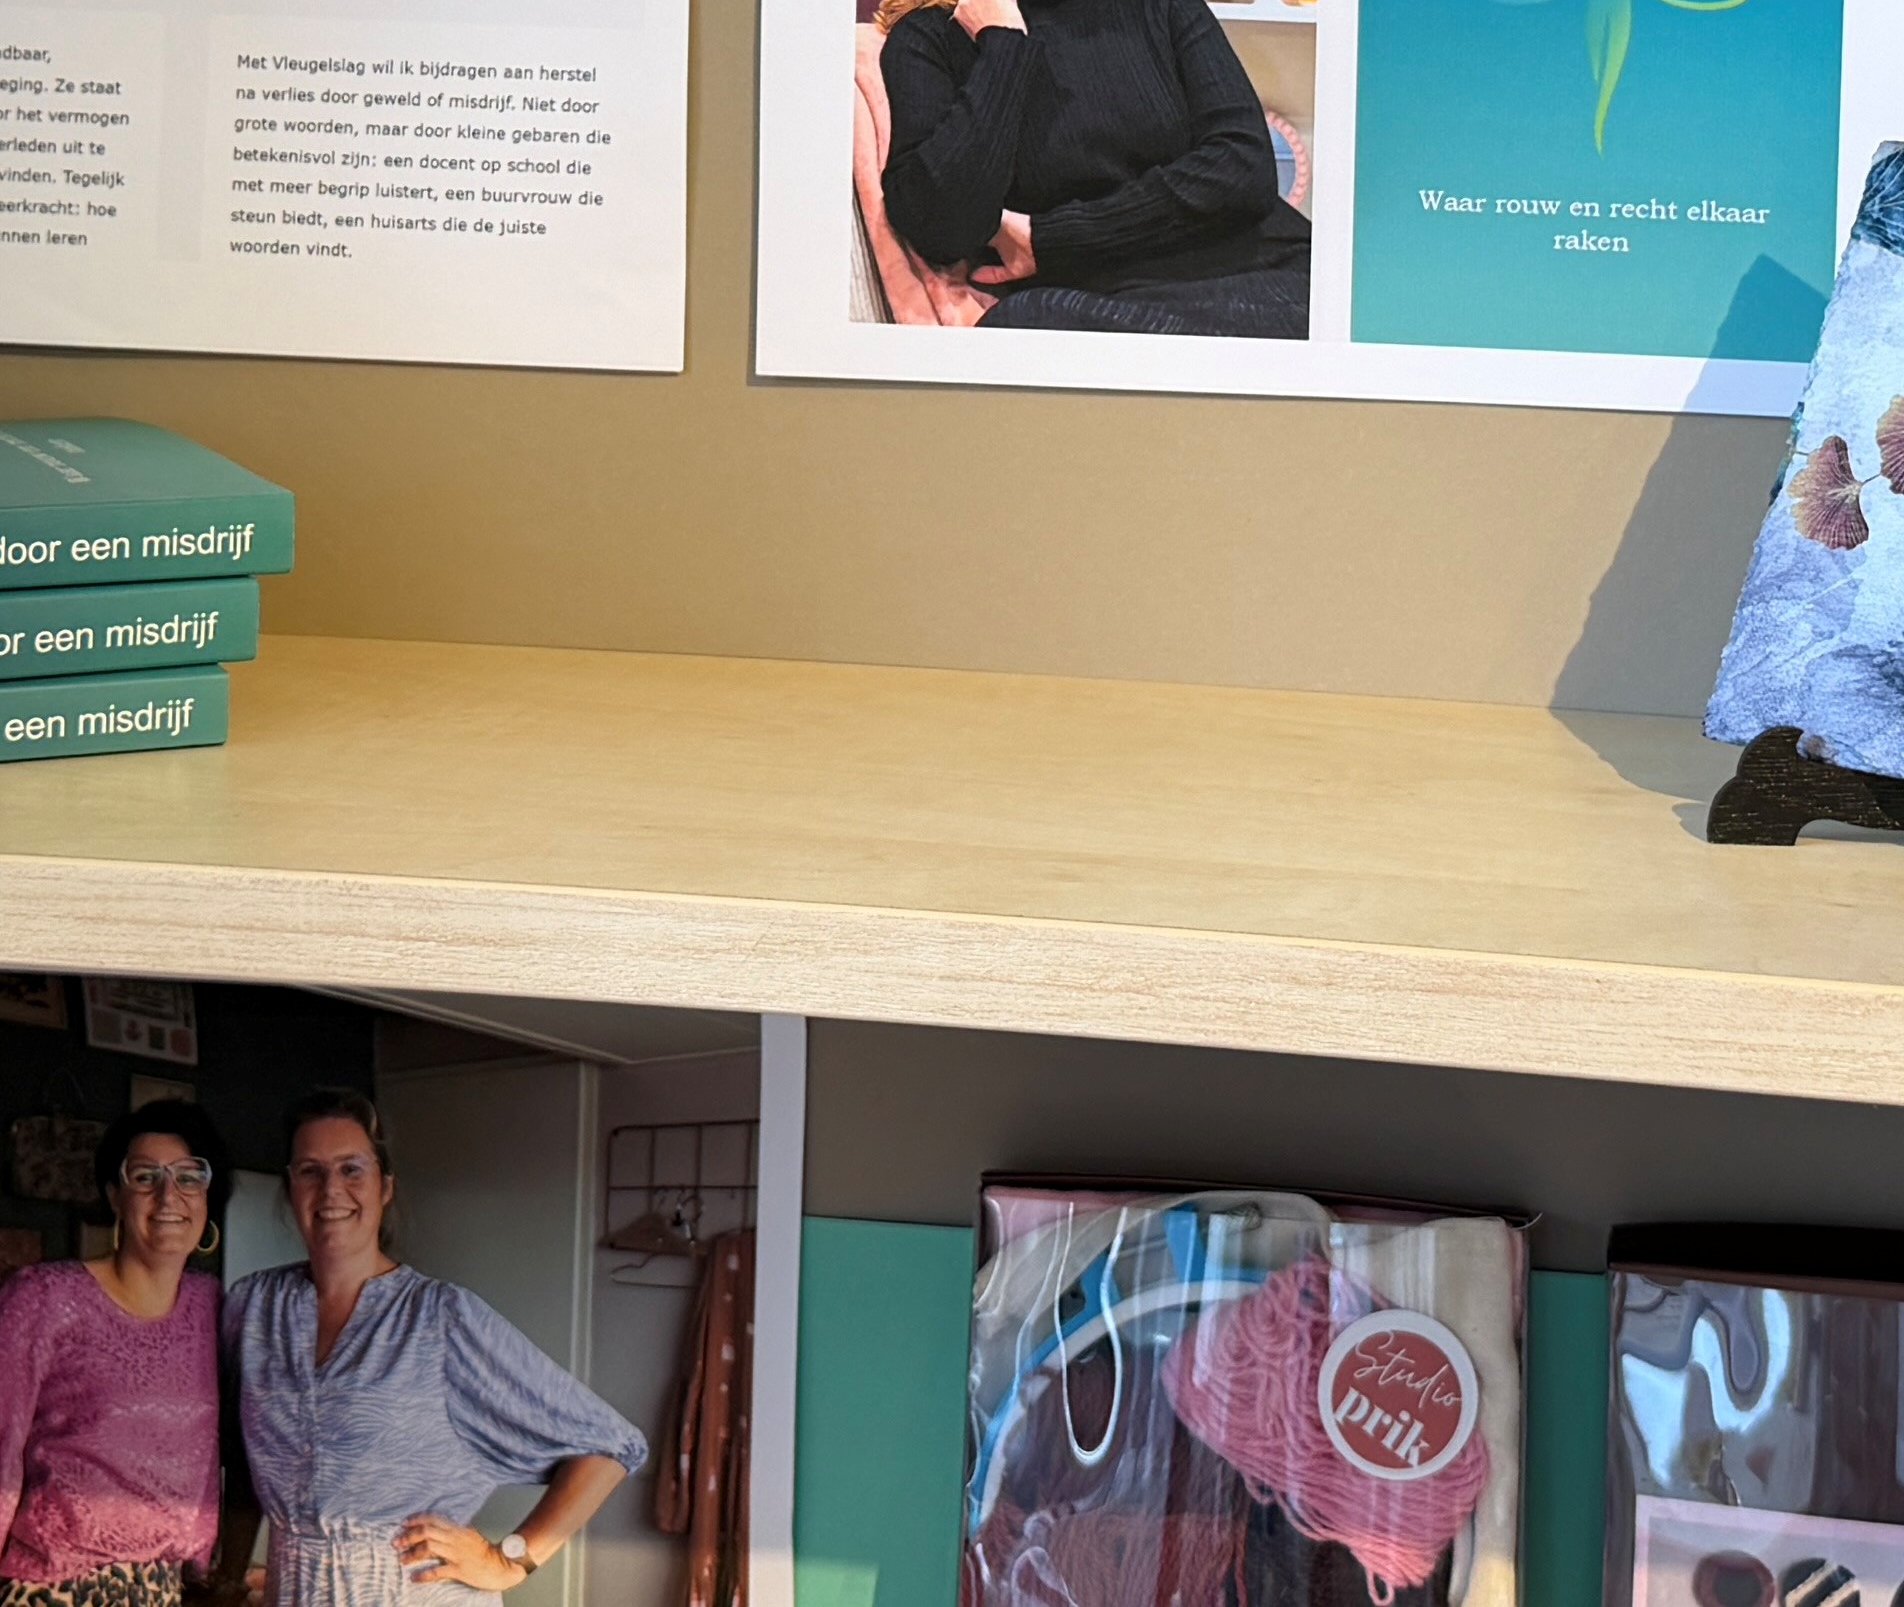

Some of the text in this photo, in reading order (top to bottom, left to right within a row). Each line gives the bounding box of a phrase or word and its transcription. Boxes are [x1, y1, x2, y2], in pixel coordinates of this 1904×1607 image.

[236, 54, 597, 83] Met Vleugelslag wil ik bijdragen aan herstel
[1419, 190, 1770, 223] Waar rouw en recht elkaar
[1554, 229, 1629, 252] raken
[71, 537, 129, 561] een
[143, 524, 254, 560] misdrijf
[35, 628, 93, 652] een
[106, 611, 219, 648] misdrijf
[5, 716, 65, 741] een
[78, 698, 194, 736] misdrijf
[1353, 1330, 1463, 1409] Studio
[1334, 1386, 1430, 1468] prik
